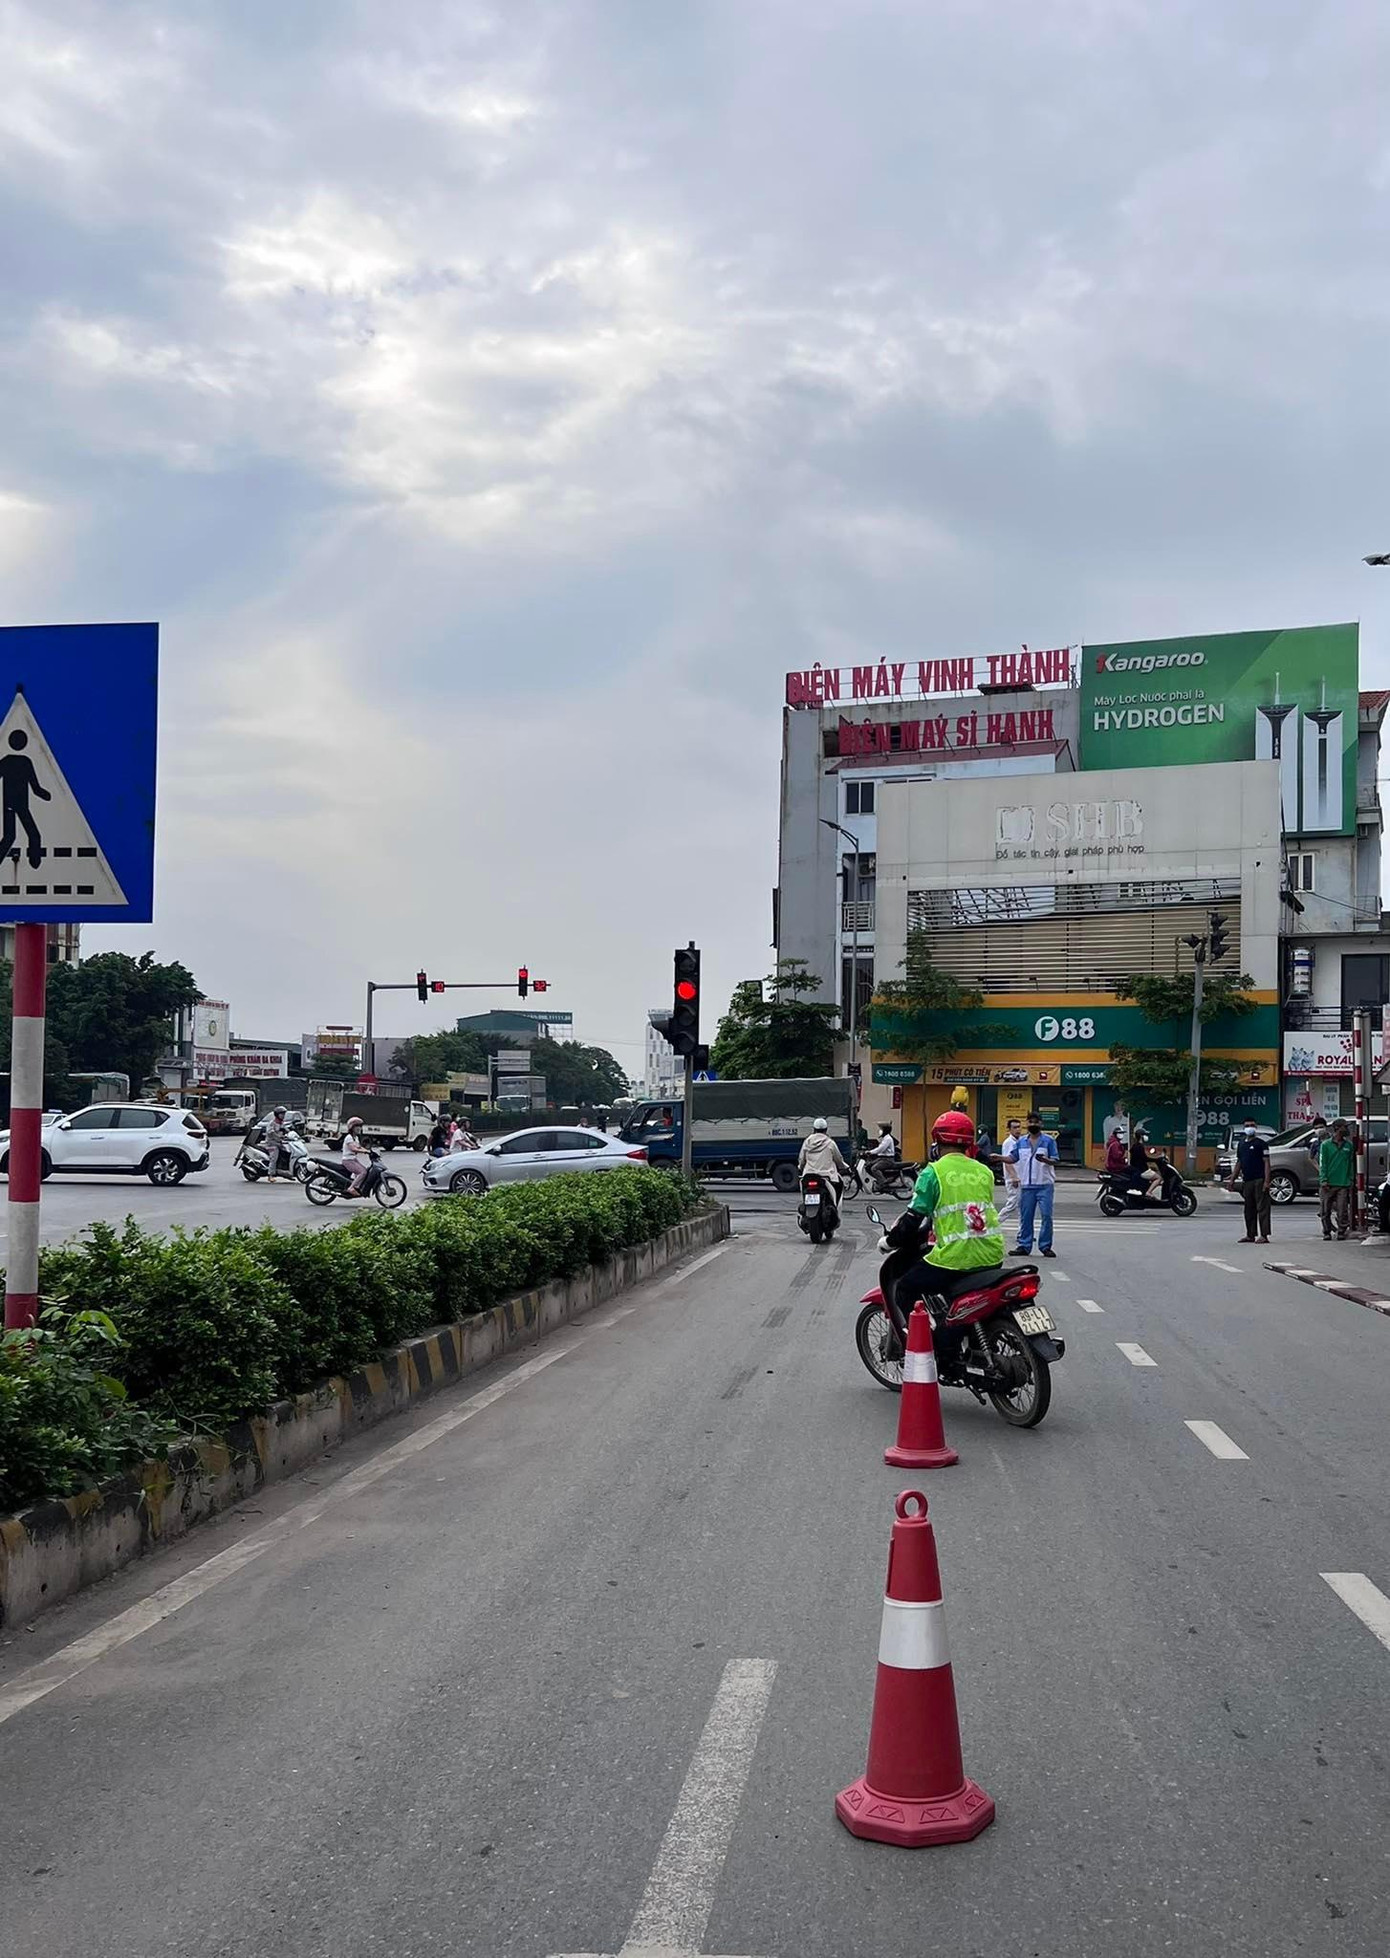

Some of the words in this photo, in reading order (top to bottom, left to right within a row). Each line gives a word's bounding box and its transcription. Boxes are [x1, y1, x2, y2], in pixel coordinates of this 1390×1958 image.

[852, 656, 905, 698] MÁY
[919, 658, 974, 692] VINH
[987, 644, 1069, 687] THÀNH
[1096, 652, 1205, 673] Kangaroo
[1094, 703, 1224, 730] HYDROGEN
[900, 713, 949, 751] MÁY
[1047, 800, 1144, 841] SHB
[1035, 1016, 1095, 1041] F88
[1317, 1055, 1353, 1065] ROYAL
[931, 1068, 943, 1080] 15
[1074, 1071, 1091, 1079] 1800
